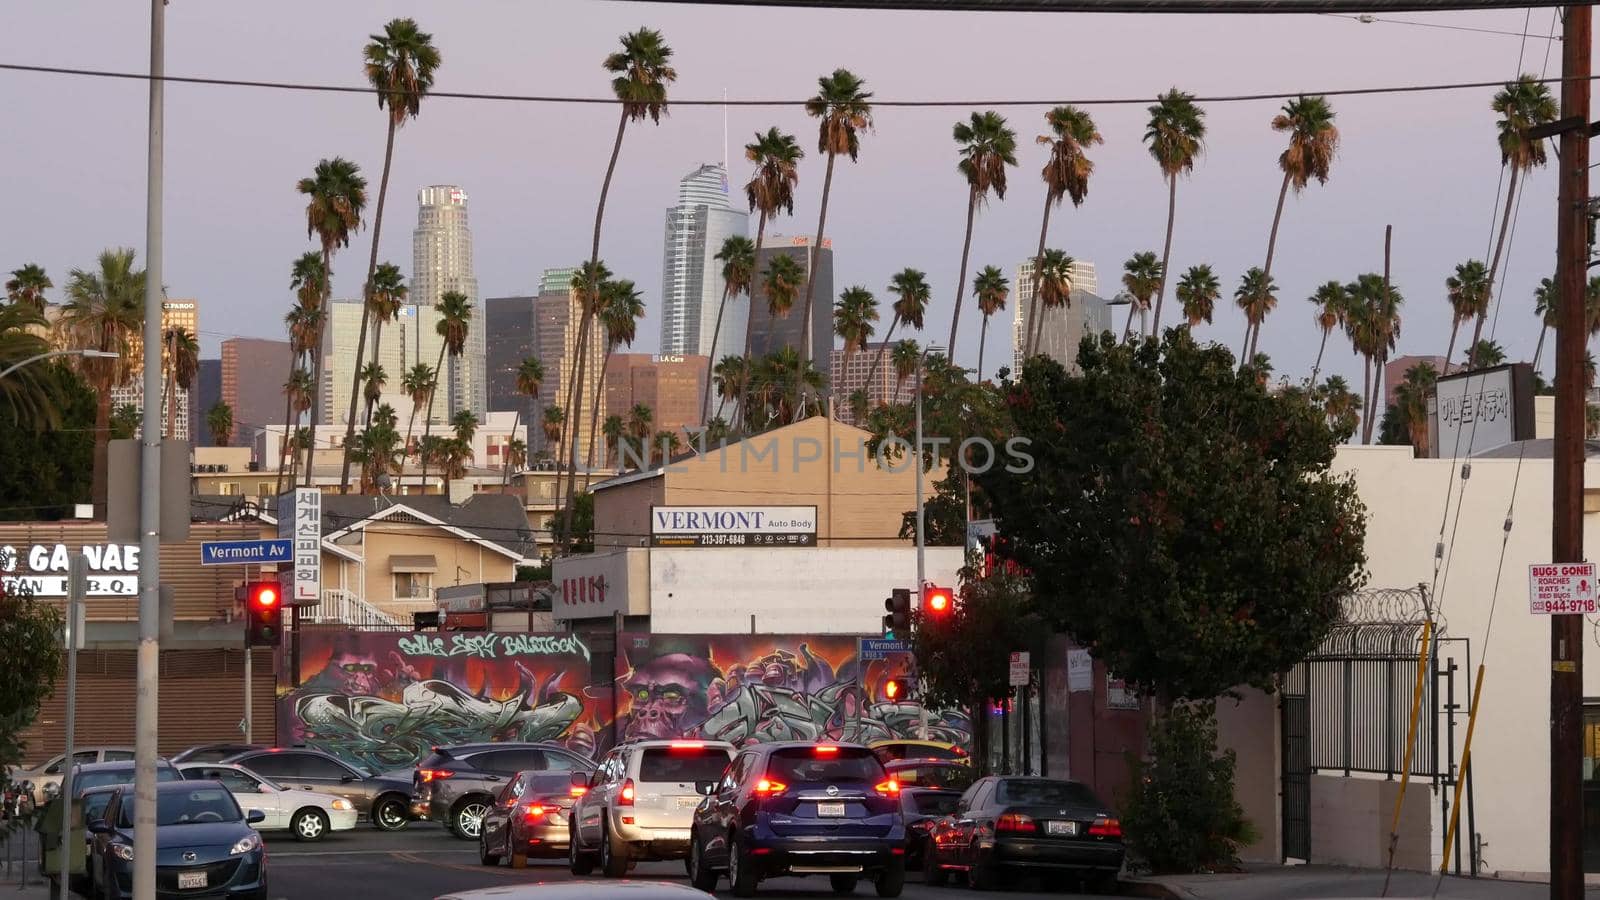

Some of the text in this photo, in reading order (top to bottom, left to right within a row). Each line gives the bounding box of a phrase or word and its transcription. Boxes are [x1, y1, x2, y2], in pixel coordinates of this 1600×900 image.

[1475, 386, 1508, 423] 자동차
[657, 511, 764, 530] VERMONT
[768, 519, 812, 529] Auto Body
[209, 544, 285, 558] Vermont Av
[82, 544, 141, 571] NAE
[1532, 566, 1593, 576] BUGS GONE!
[1538, 577, 1570, 585] ROACHES
[1545, 600, 1595, 612] 944-9718
[869, 641, 903, 650] Vermont
